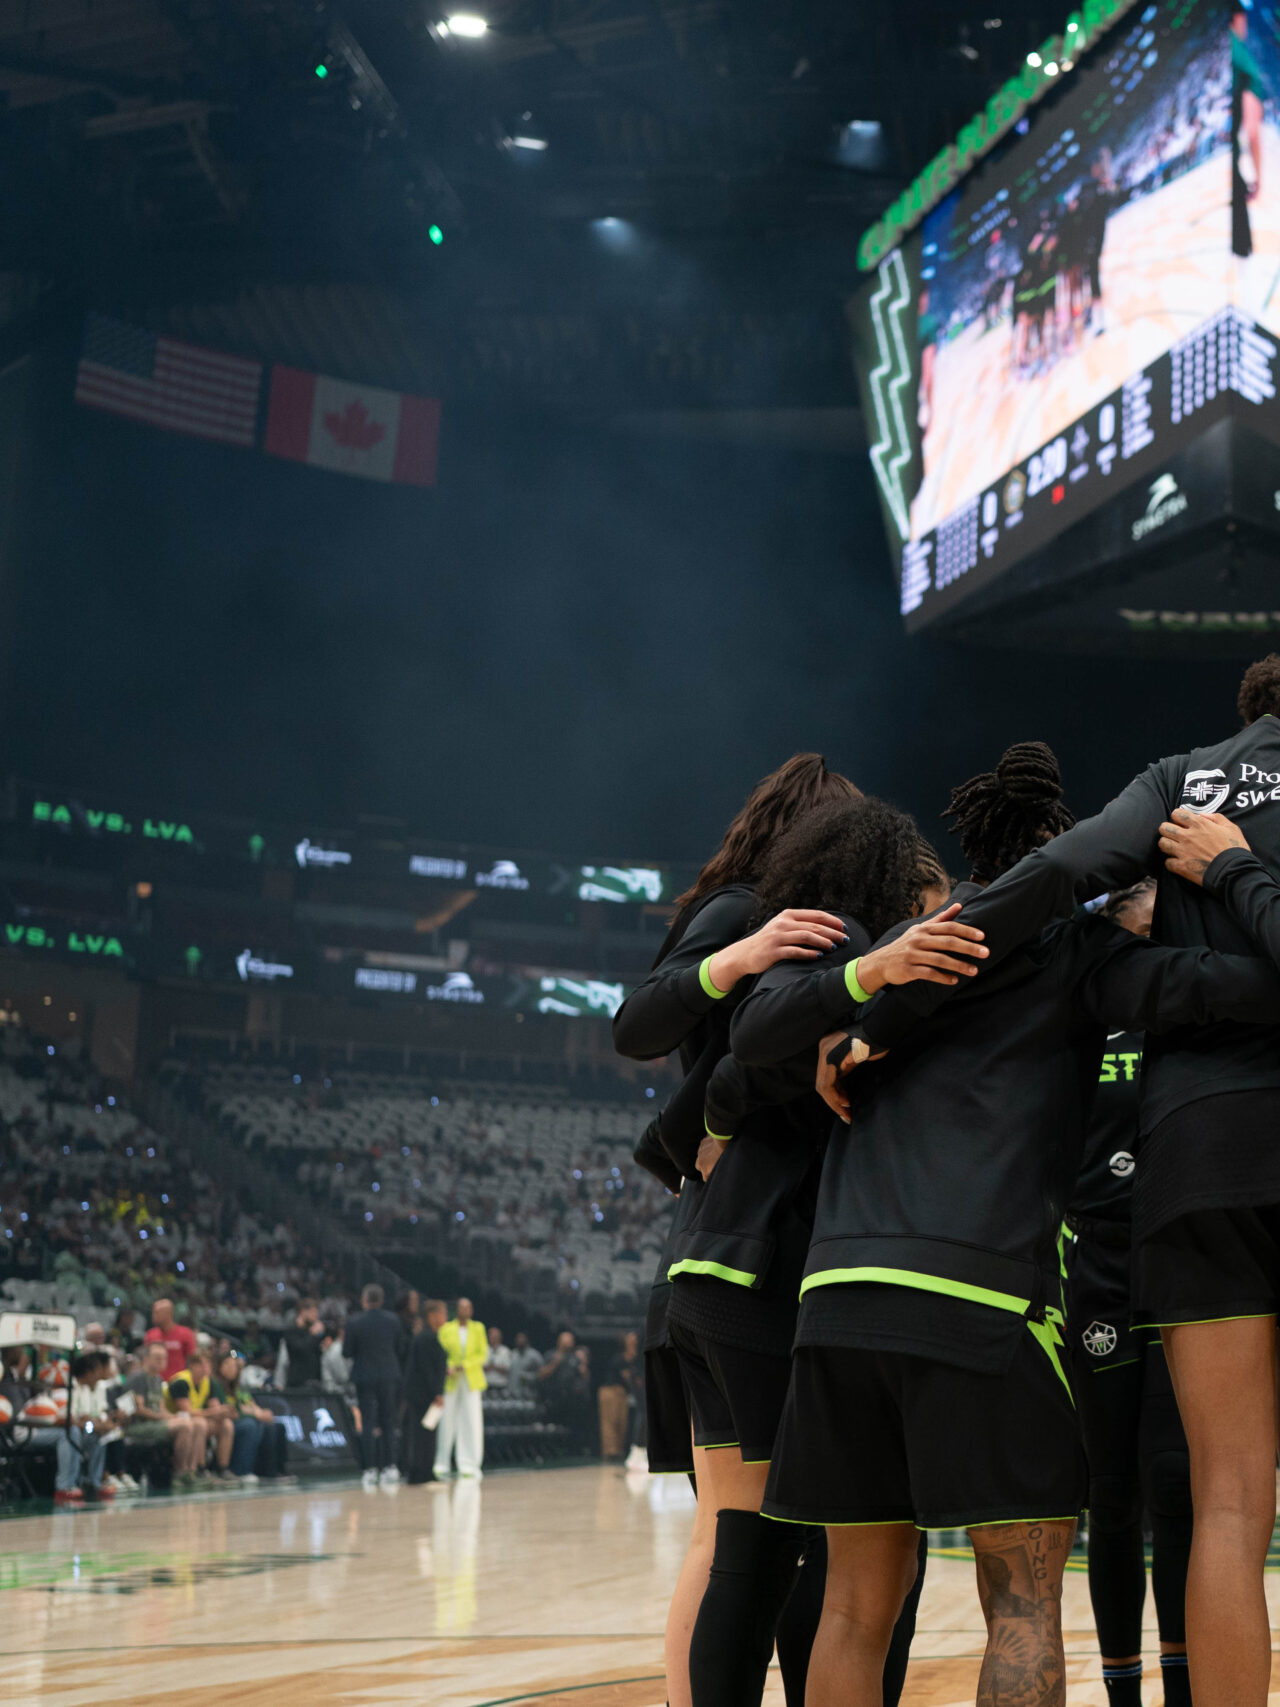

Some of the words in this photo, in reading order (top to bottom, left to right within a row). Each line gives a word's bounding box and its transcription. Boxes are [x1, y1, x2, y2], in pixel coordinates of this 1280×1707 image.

[143, 819, 193, 843] LVA
[68, 932, 123, 957] LVA
[1099, 1051, 1143, 1083] ST
[1026, 1521, 1048, 1580] OING
